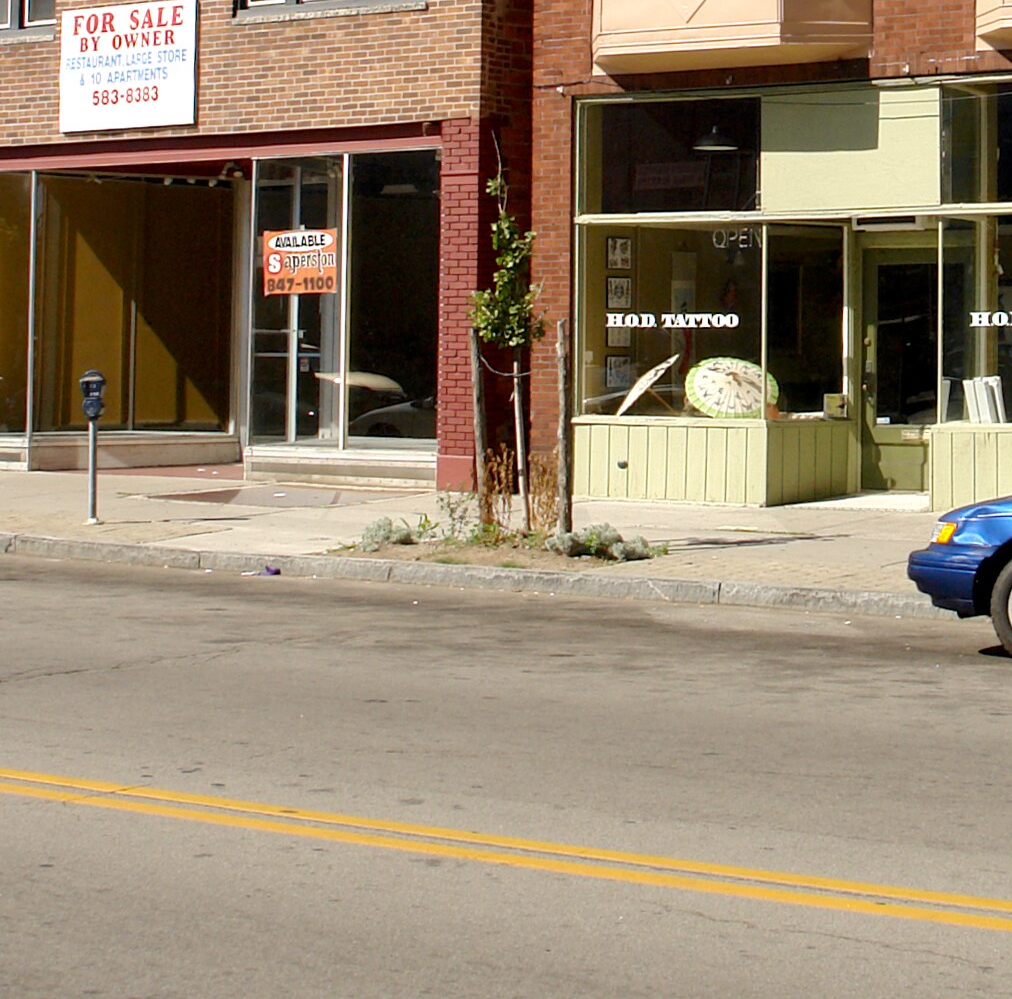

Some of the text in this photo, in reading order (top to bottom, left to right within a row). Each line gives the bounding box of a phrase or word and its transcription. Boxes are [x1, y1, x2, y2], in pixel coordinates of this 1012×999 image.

[73, 5, 184, 35] FOR SALE
[80, 29, 175, 52] BY OWNER
[158, 49, 187, 63] STORE
[80, 67, 168, 86] & 10 APARTMENTS
[92, 85, 159, 106] 583-8383
[275, 234, 326, 248] AVAILABLE
[712, 228, 762, 248] OPEN
[267, 276, 333, 292] 847-1100
[661, 313, 740, 328] TATTOO
